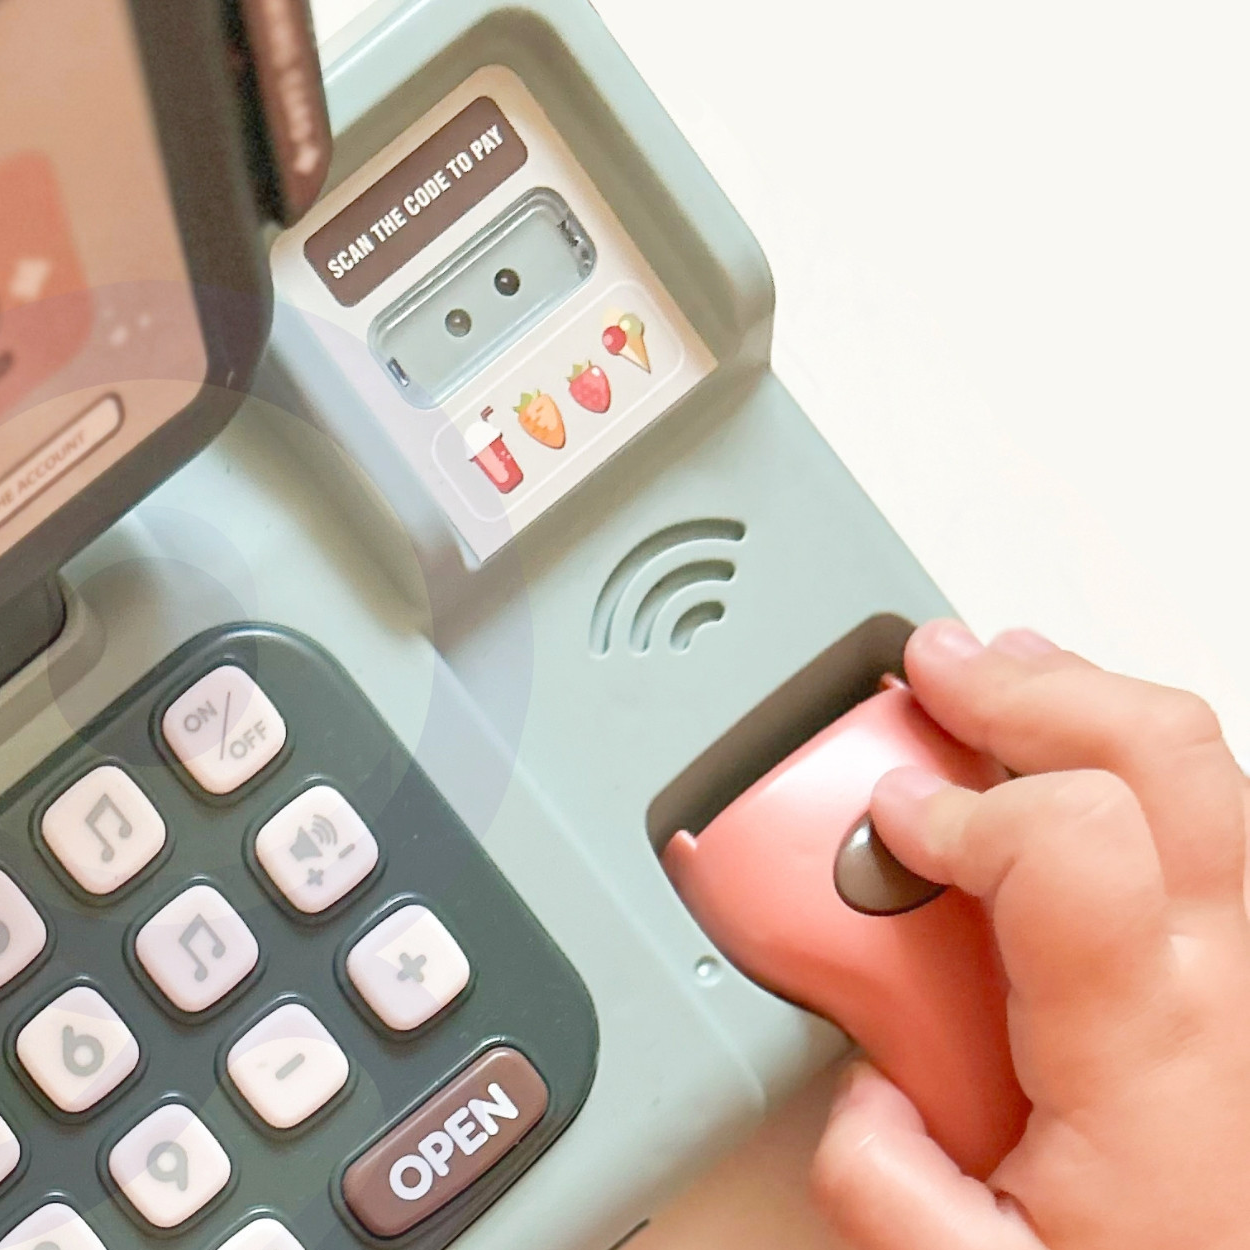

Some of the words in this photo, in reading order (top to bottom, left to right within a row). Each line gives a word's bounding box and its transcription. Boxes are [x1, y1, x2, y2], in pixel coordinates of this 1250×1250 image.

[327, 234, 375, 279] SCAN
[370, 207, 407, 242] THE
[403, 170, 451, 216] CODE
[446, 152, 473, 179] TO
[470, 124, 503, 161] PAY
[17, 429, 86, 493] ACCOUNT
[60, 1024, 106, 1078] 6
[144, 1138, 189, 1192] 9
[389, 1082, 520, 1201] OPEN
